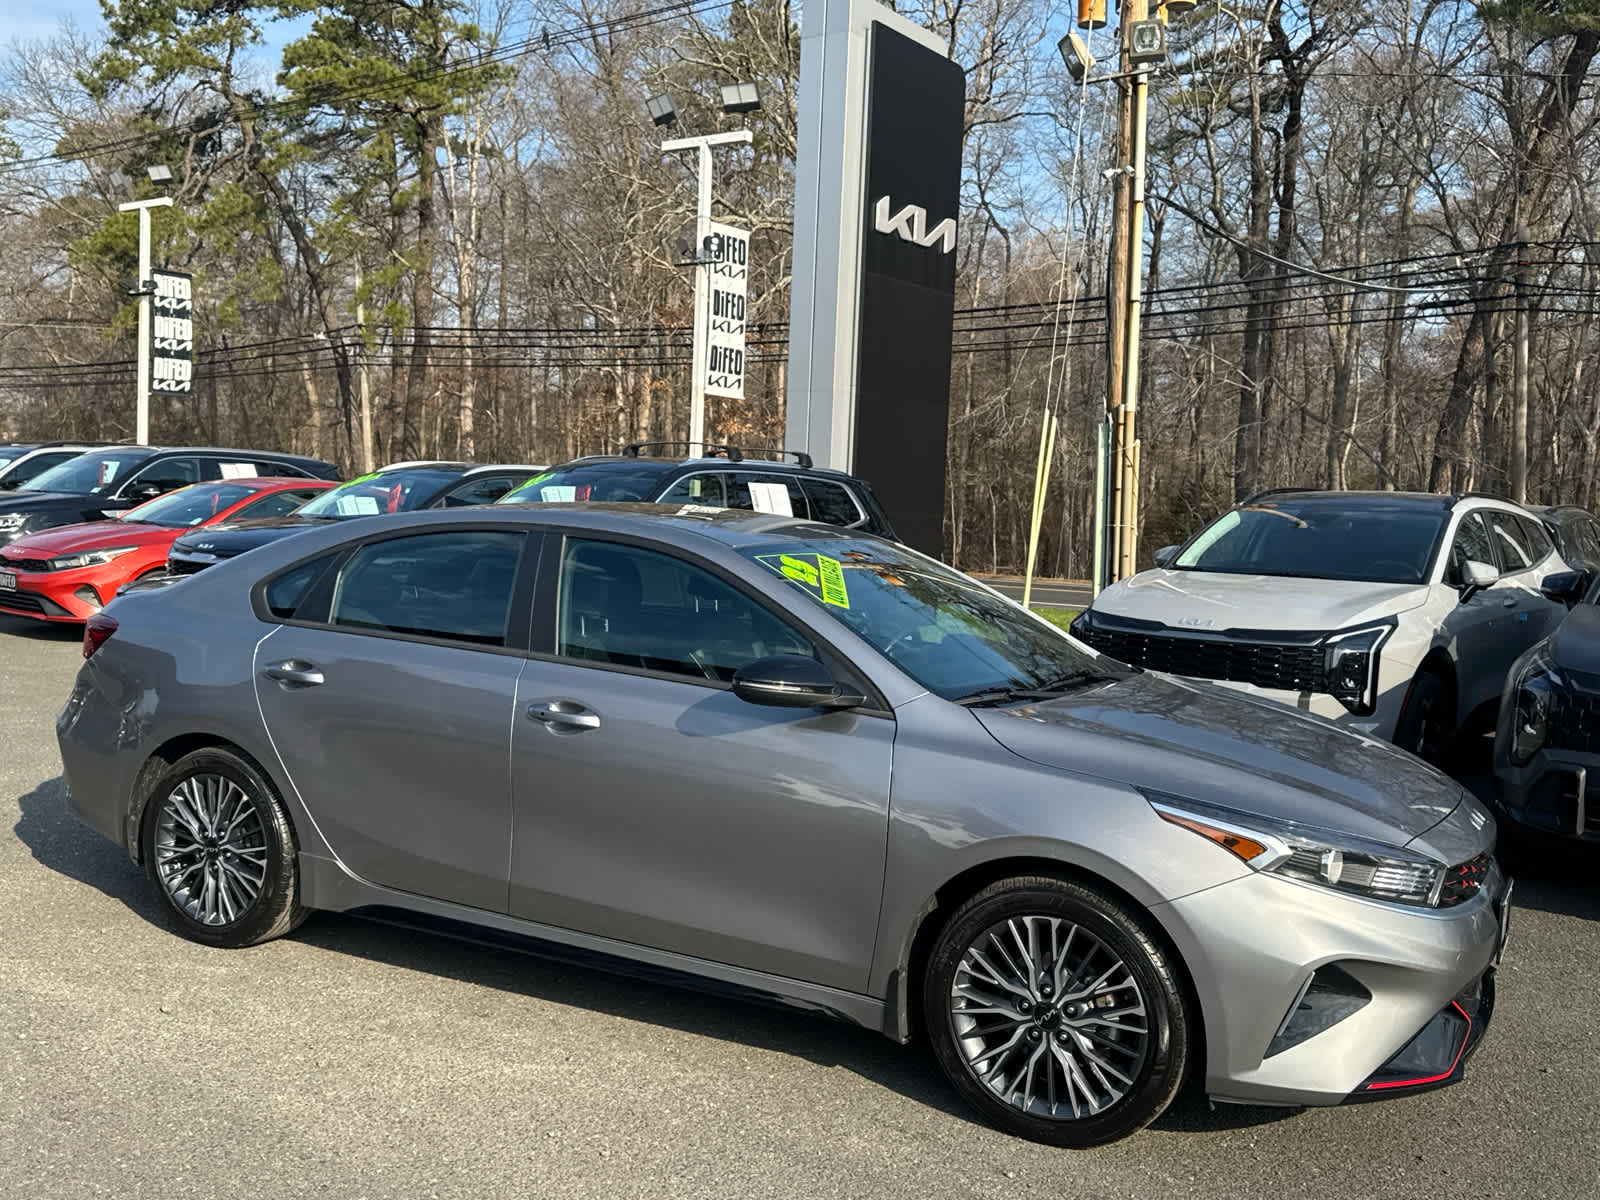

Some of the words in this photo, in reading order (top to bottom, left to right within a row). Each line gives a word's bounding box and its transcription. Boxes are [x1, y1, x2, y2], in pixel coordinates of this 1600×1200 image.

[875, 195, 956, 254] KIA
[713, 263, 746, 279] KIA
[712, 319, 744, 334] KIA
[708, 374, 742, 389] KIA
